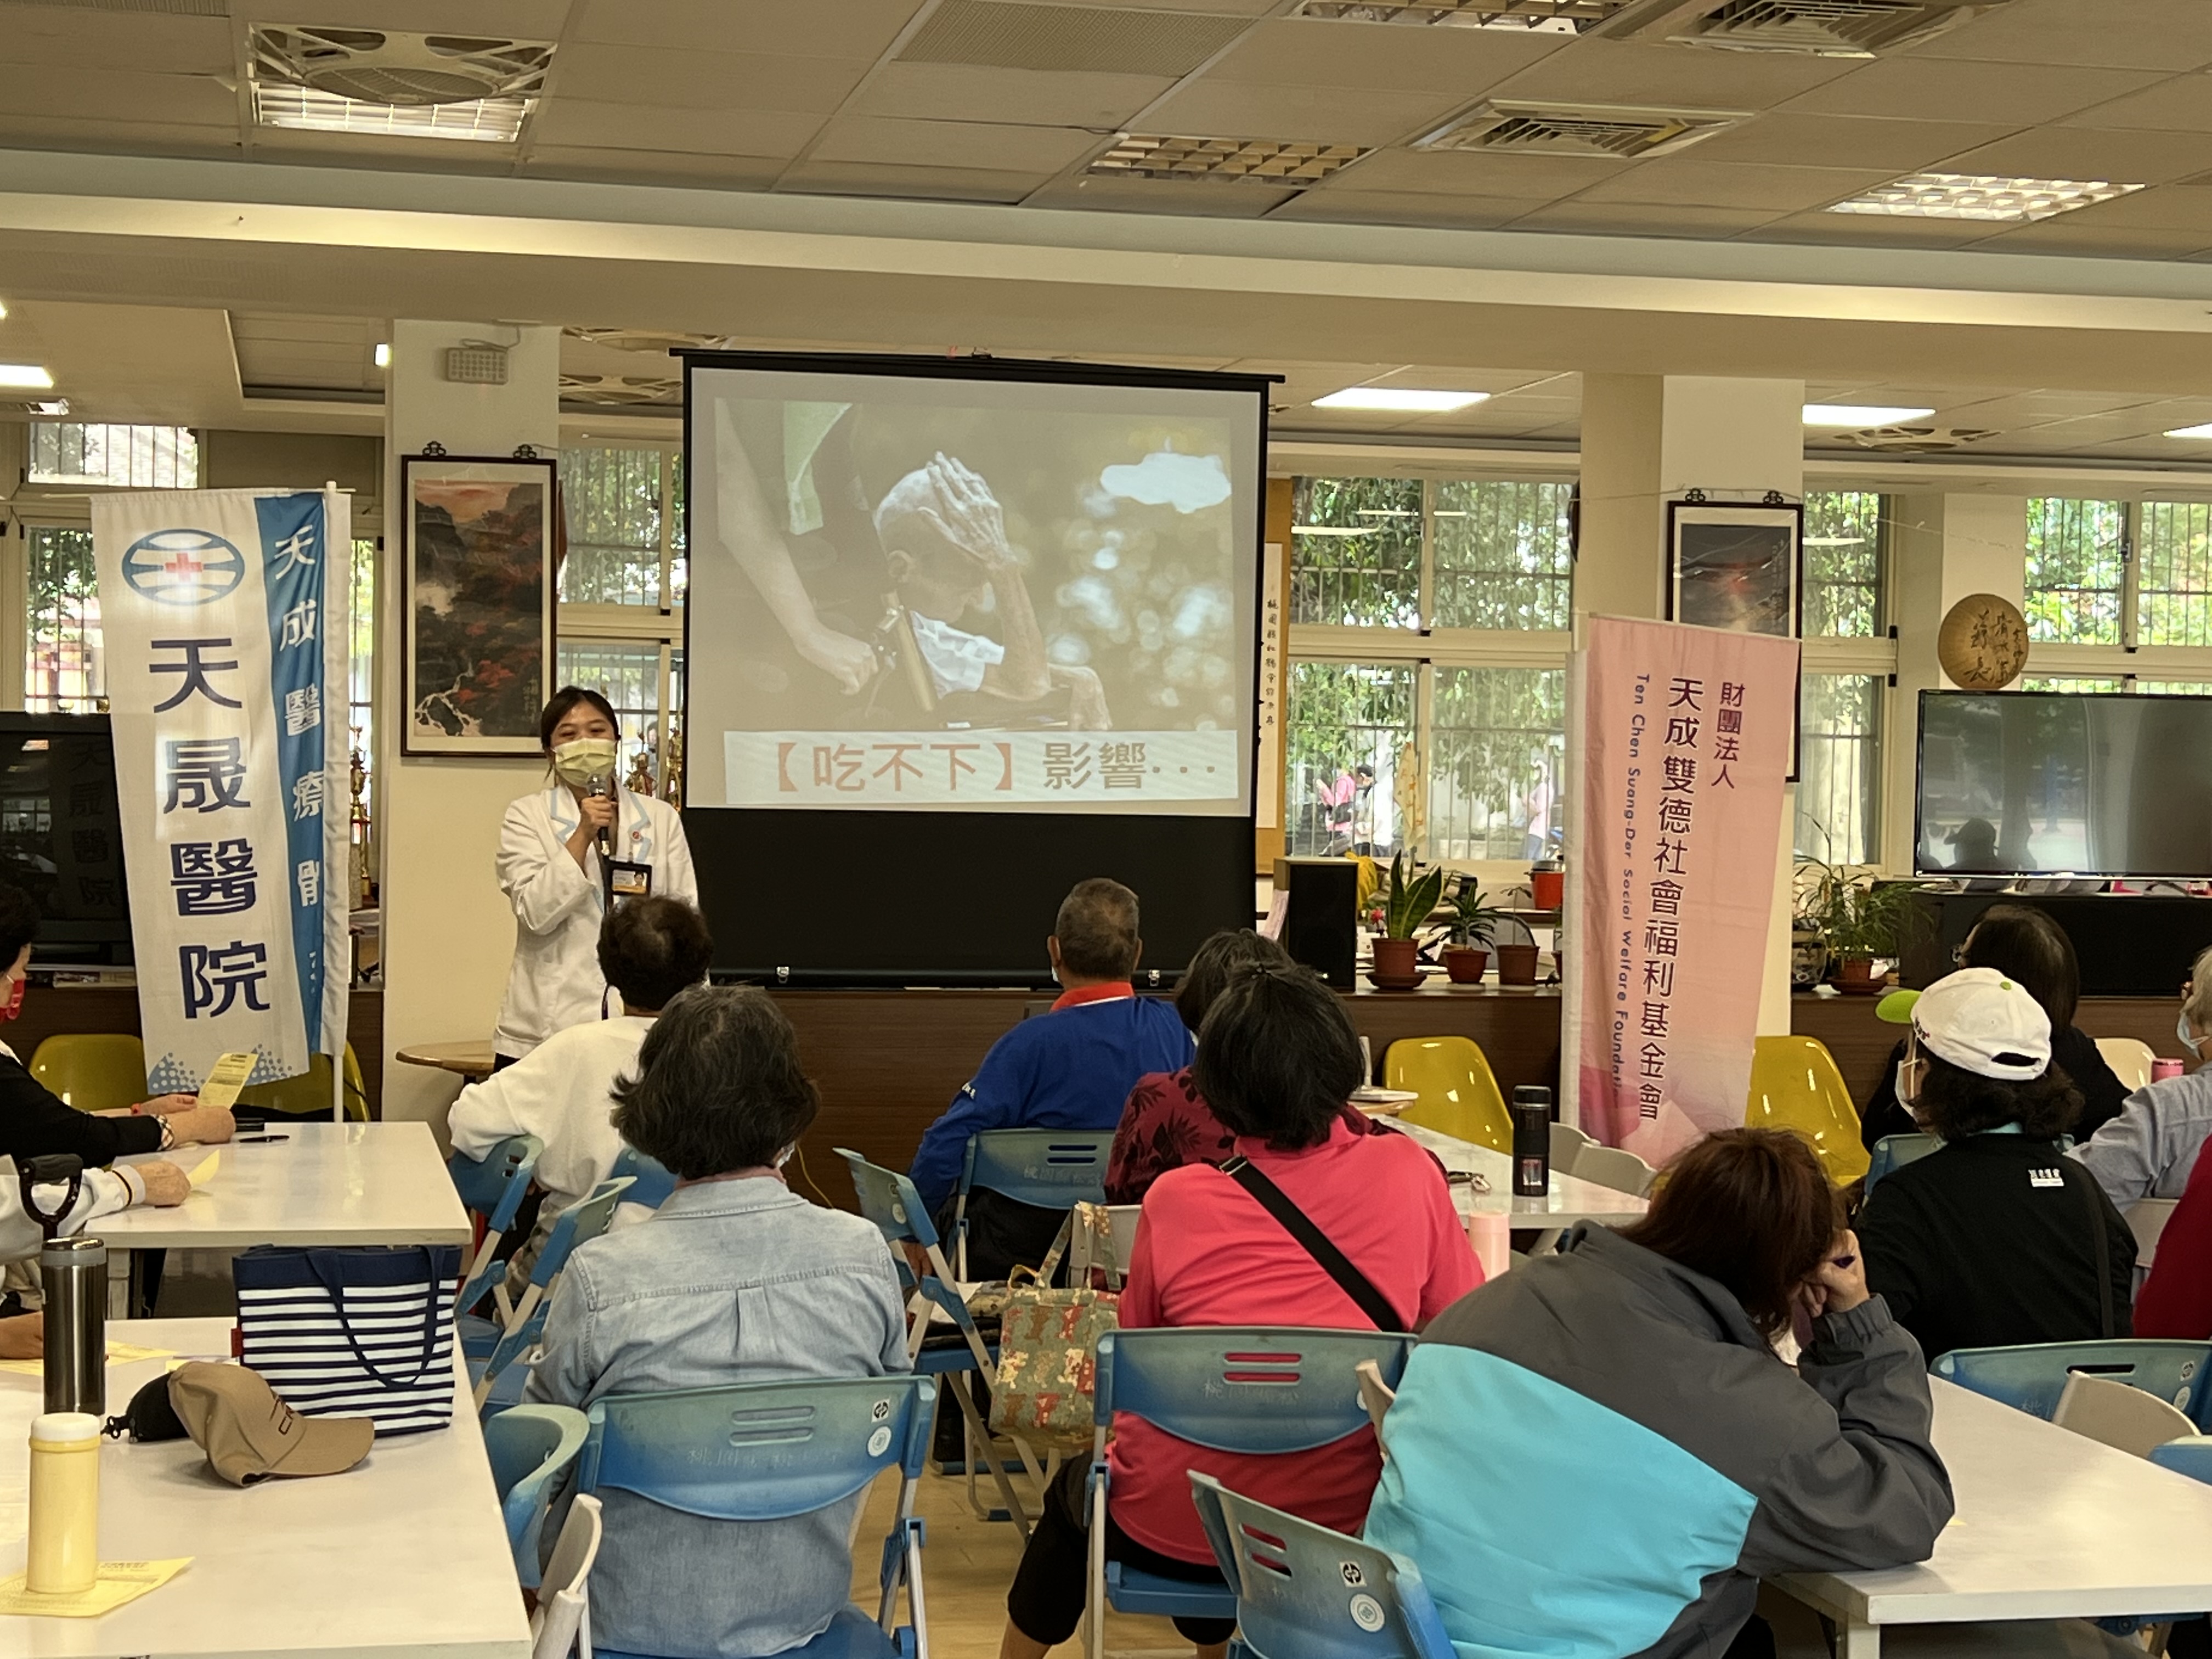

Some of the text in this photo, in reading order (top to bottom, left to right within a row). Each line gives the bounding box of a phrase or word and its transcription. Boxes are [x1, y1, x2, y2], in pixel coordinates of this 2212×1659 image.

[1634, 674, 1650, 704] Ten
[1711, 681, 1746, 789] 財團法人
[275, 524, 324, 995] 天成醫療
[1629, 714, 1645, 758] Chen
[149, 637, 271, 1019] 天晟醫院
[1622, 767, 1641, 859] Suang-Der
[1621, 869, 1634, 920] Social
[1639, 677, 1704, 1120] 天成雙德社會福利基金會
[1616, 930, 1633, 1002] Welfare
